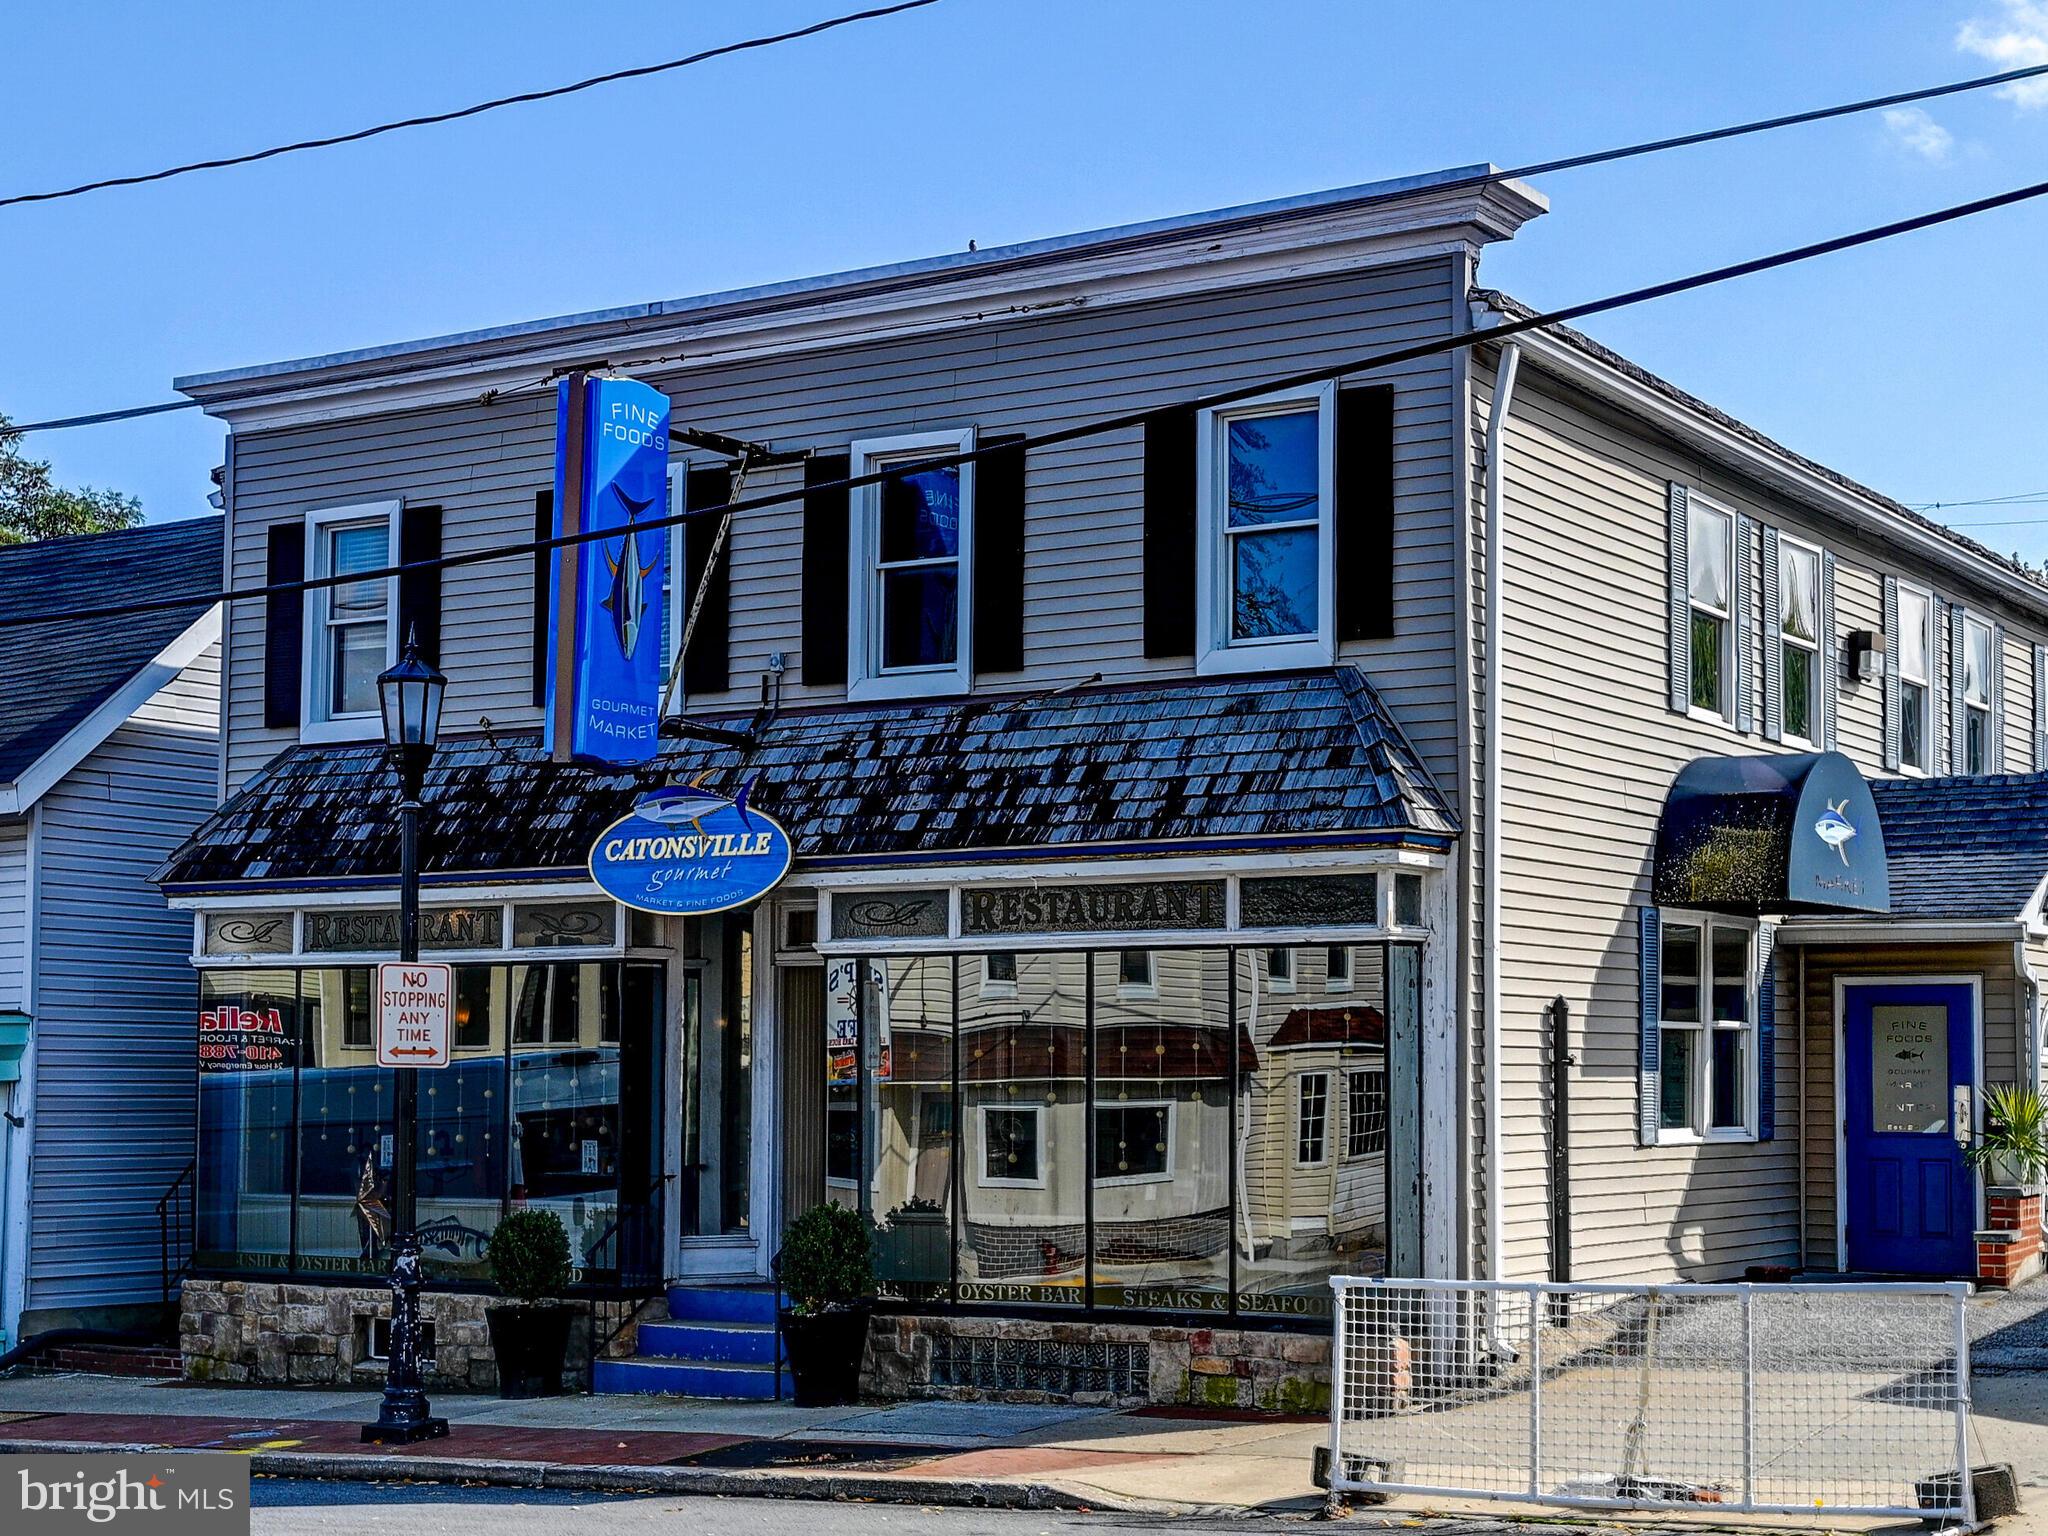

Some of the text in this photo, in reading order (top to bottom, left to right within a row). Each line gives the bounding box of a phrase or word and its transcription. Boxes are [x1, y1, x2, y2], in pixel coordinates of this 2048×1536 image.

[612, 403, 659, 430] FINE
[604, 422, 665, 451] FOODS
[592, 698, 655, 717] GOURMET
[589, 714, 656, 740] MARKET
[605, 832, 772, 862] CATONSVILLE
[646, 860, 732, 892] gourmet
[636, 888, 744, 908] MARKET & FINE FOODS
[969, 883, 1220, 931] RESTAURANT
[310, 909, 499, 949] RESTARANT
[402, 971, 428, 988] NO
[383, 991, 446, 1009] STOPPING
[398, 1011, 430, 1025] ANY
[1891, 1020, 1927, 1031] FINE
[396, 1028, 431, 1042] TIME
[1886, 1034, 1933, 1043] FOODS
[236, 1254, 271, 1268] USHI
[278, 1255, 289, 1269] &
[357, 1259, 388, 1274] BAR
[958, 1283, 1032, 1301] OYSTER
[1040, 1287, 1082, 1303] BAR
[1123, 1289, 1202, 1309] STEAKS
[1211, 1294, 1226, 1310] &
